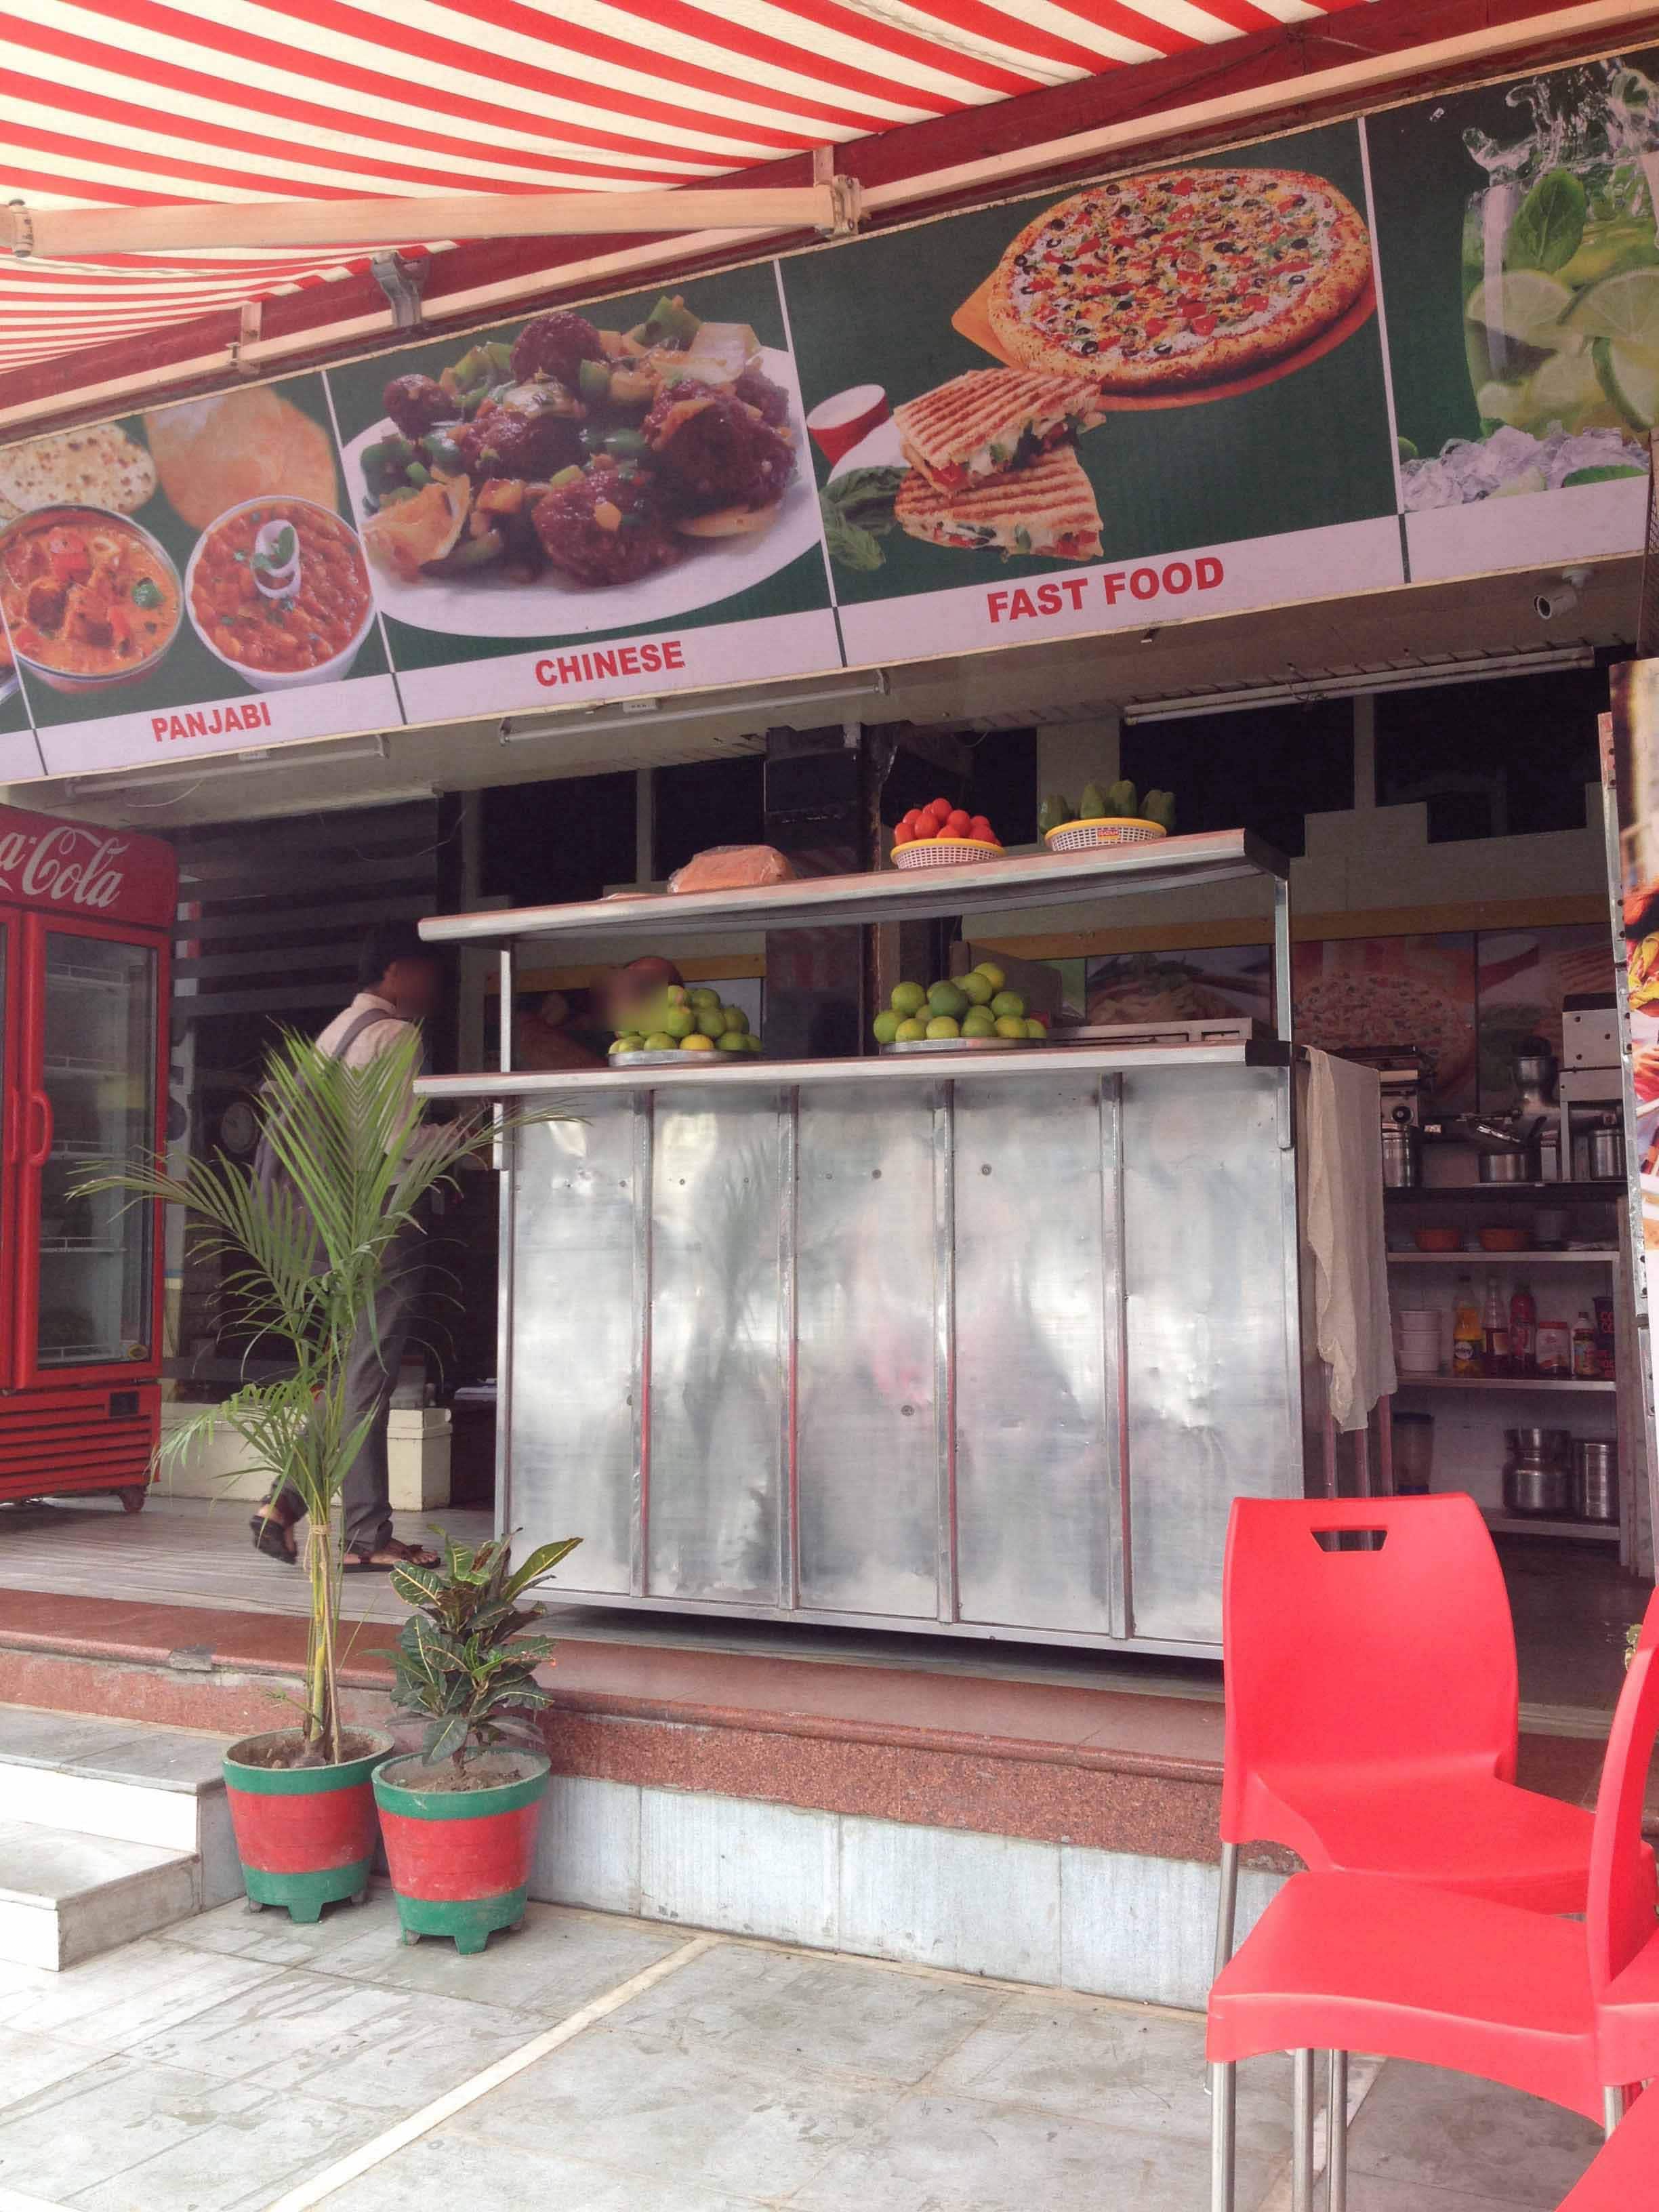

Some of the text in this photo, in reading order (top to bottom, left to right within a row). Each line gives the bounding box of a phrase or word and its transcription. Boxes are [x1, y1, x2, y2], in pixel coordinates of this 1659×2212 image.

[986, 556, 1225, 624] FAST FOOD
[534, 640, 685, 687] CHINESE
[151, 701, 271, 742] PANJABI
[0, 825, 130, 908] a-Cola
